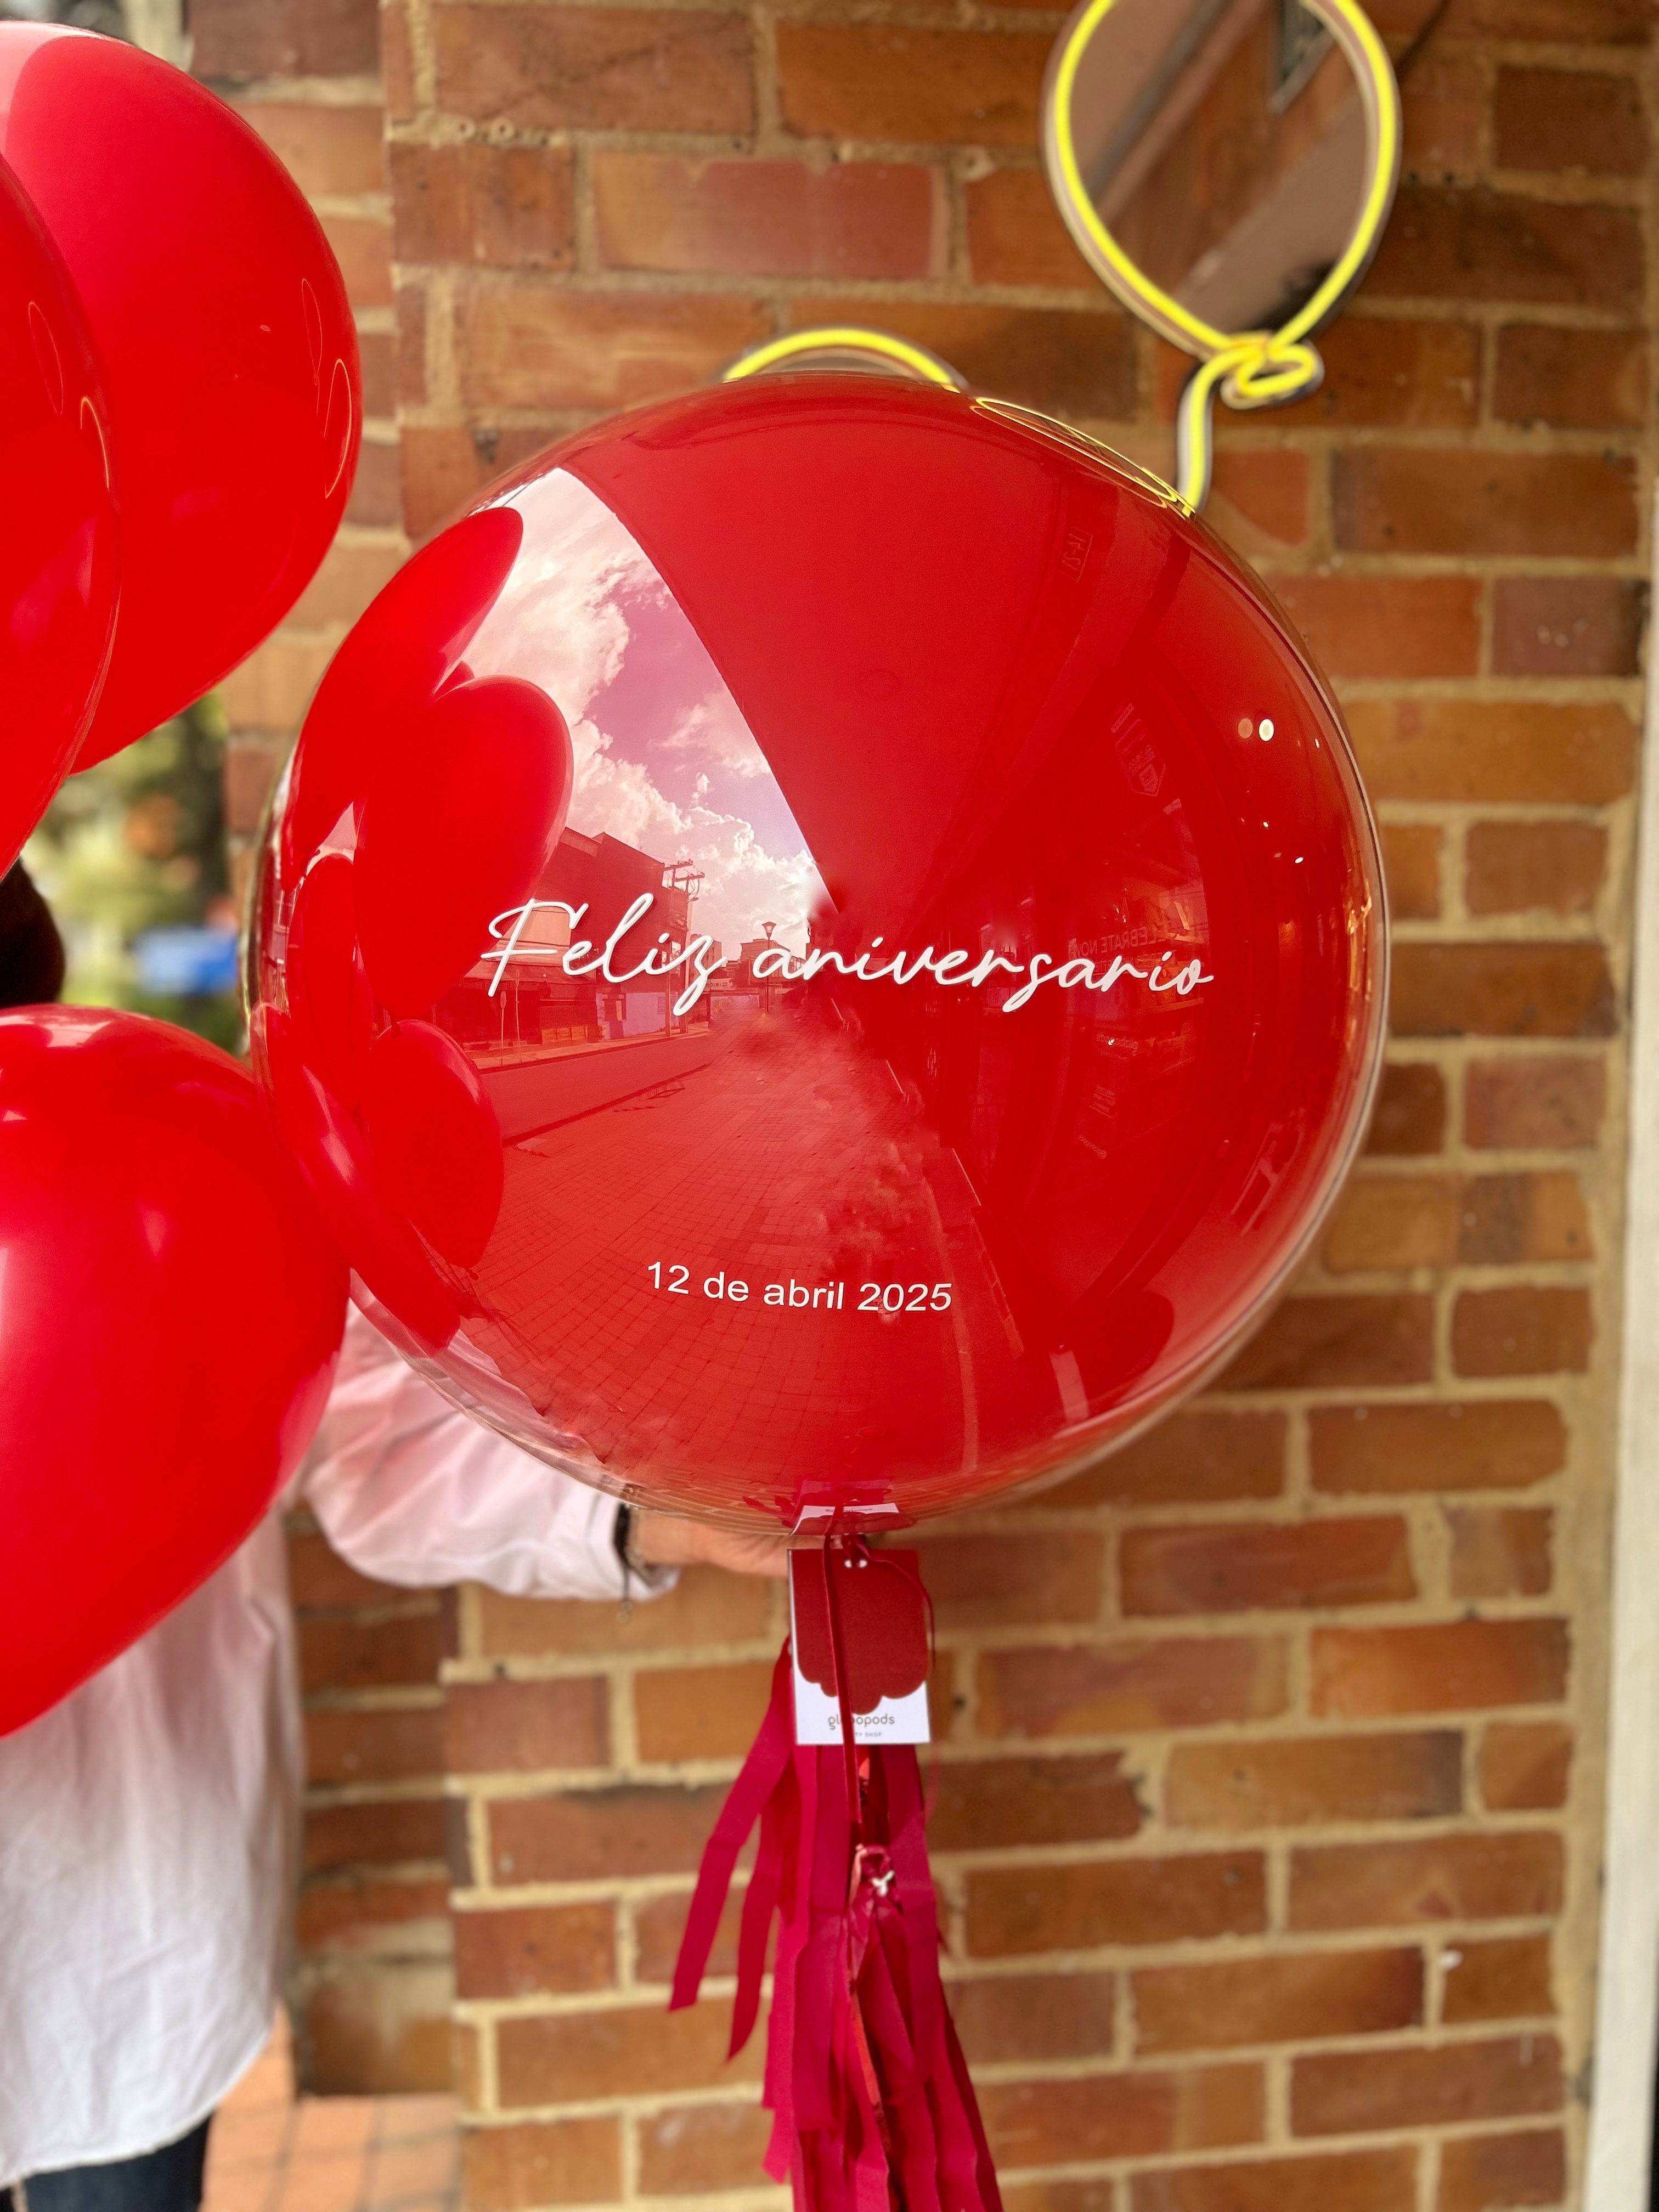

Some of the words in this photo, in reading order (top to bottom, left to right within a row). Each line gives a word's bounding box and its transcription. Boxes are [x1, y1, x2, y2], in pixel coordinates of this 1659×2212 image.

[480, 893, 728, 1016] Feliz
[752, 936, 1215, 1013] aniversario
[647, 1261, 690, 1295] 12
[703, 1272, 749, 1302] de
[763, 1279, 844, 1310] abril
[857, 1283, 953, 1312] 2025
[828, 1713, 895, 1730] glopods
